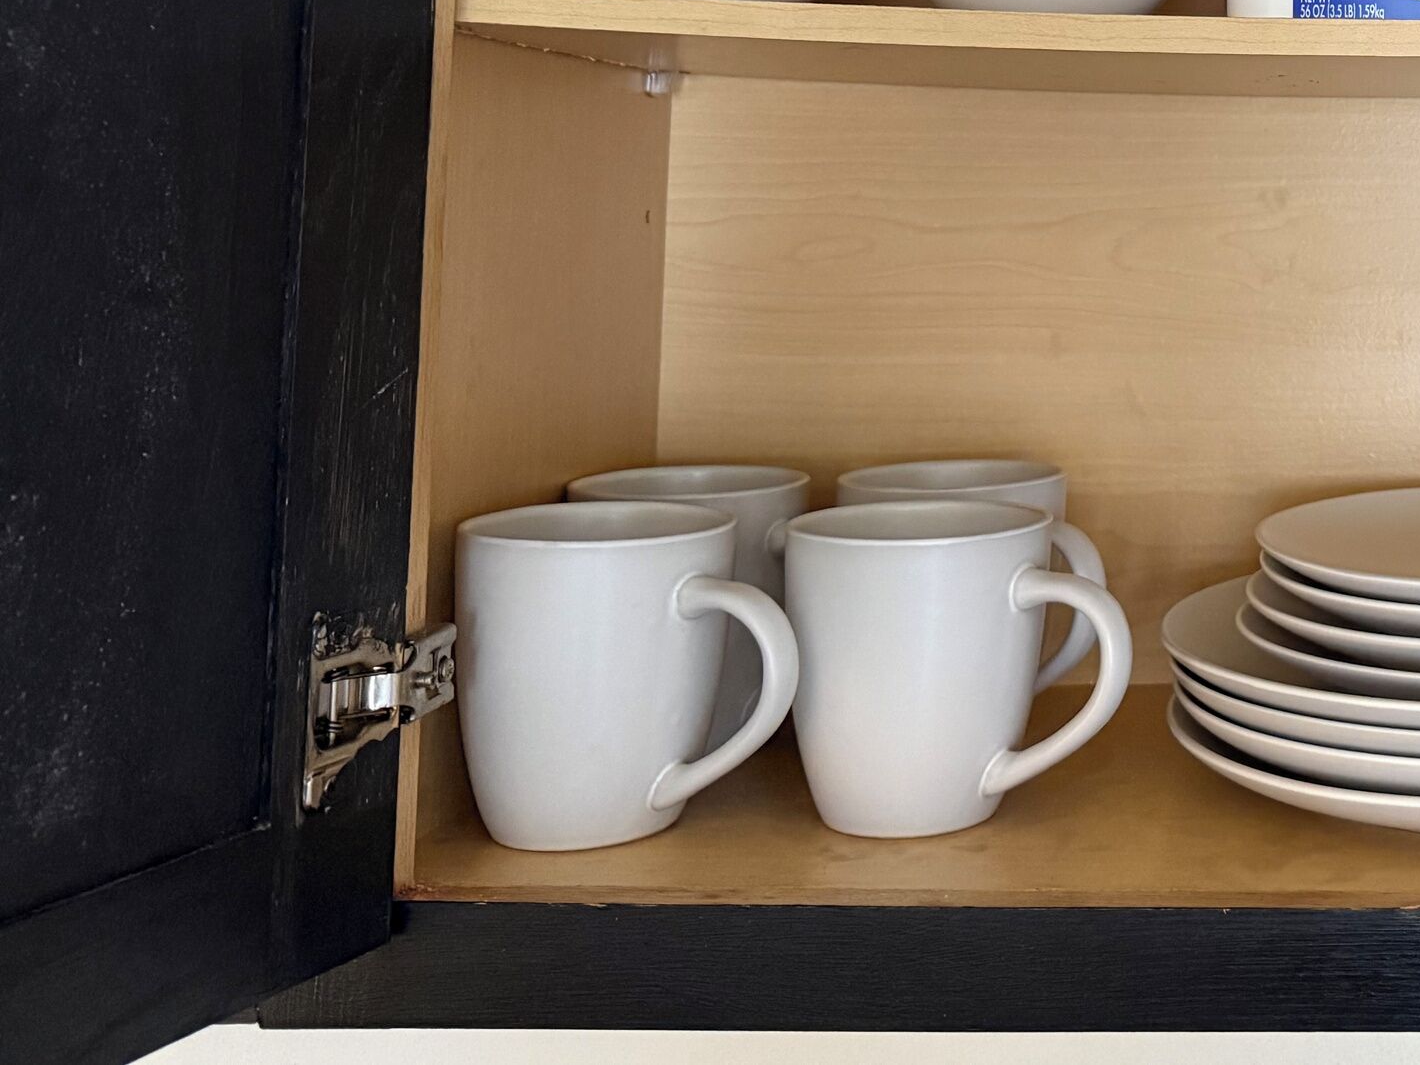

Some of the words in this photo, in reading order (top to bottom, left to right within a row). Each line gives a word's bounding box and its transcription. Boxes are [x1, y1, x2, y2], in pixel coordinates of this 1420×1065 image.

[1300, 3, 1311, 18] 56
[1312, 3, 1326, 18] OZ
[1328, 3, 1342, 19] (3.5
[1344, 3, 1356, 19] LB)
[1358, 3, 1385, 19] 1.59kg
